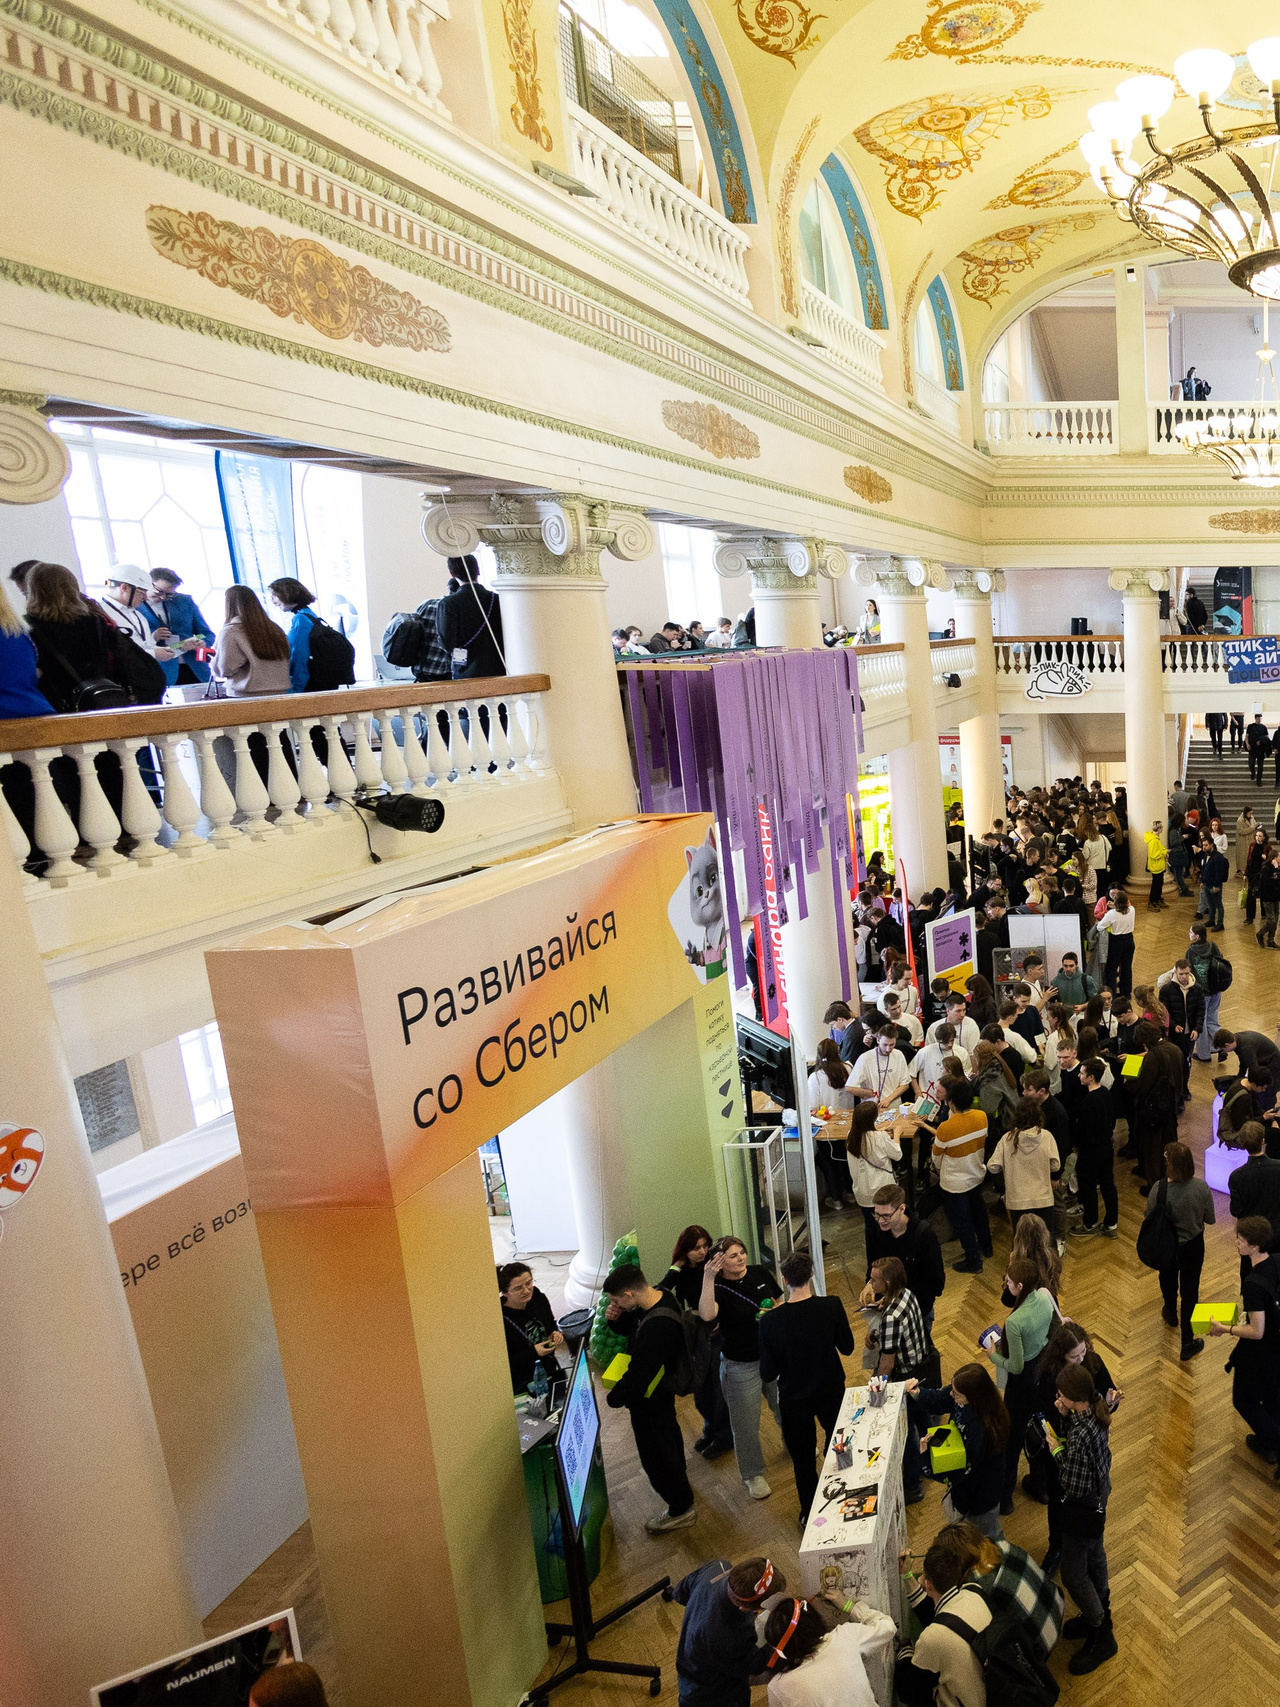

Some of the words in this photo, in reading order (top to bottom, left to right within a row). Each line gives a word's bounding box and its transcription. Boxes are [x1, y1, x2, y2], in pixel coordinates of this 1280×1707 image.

[806, 831, 814, 858] Пиши
[397, 910, 617, 1046] Развивайся
[705, 1000, 724, 1018] Помоги
[413, 1073, 463, 1129] со
[475, 985, 610, 1088] Сбером
[167, 1222, 205, 1260] всё
[166, 1655, 236, 1691] NAUMEN
